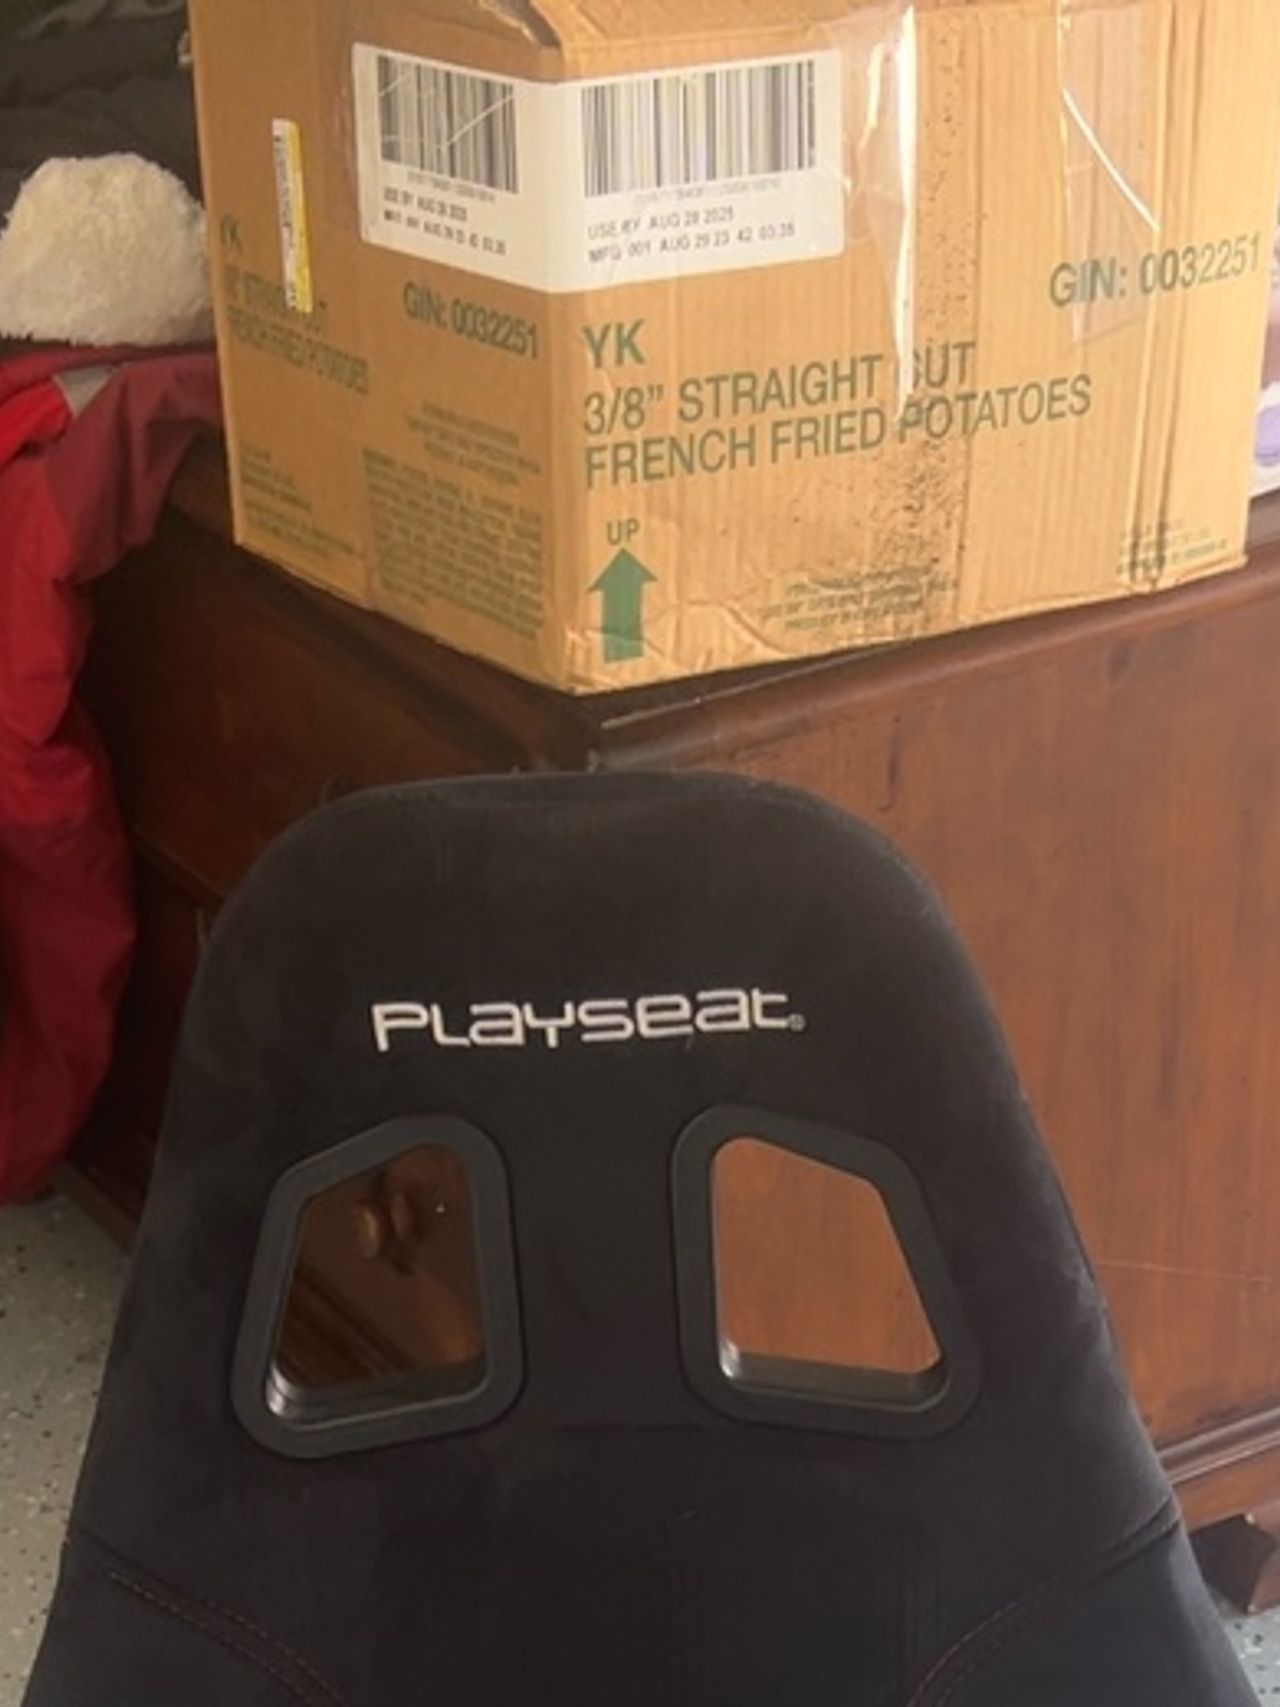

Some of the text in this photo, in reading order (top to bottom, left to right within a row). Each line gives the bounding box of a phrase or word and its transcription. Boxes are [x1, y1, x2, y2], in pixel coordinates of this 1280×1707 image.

[1048, 232, 1261, 308] GIN: 0032251
[451, 297, 538, 360] 0032251
[582, 318, 646, 369] YK
[677, 353, 884, 423] STRAIGHT
[585, 424, 757, 490] FRENCH
[770, 406, 887, 465] FRIED
[897, 373, 1092, 444] POTATOES
[606, 517, 640, 547] UP
